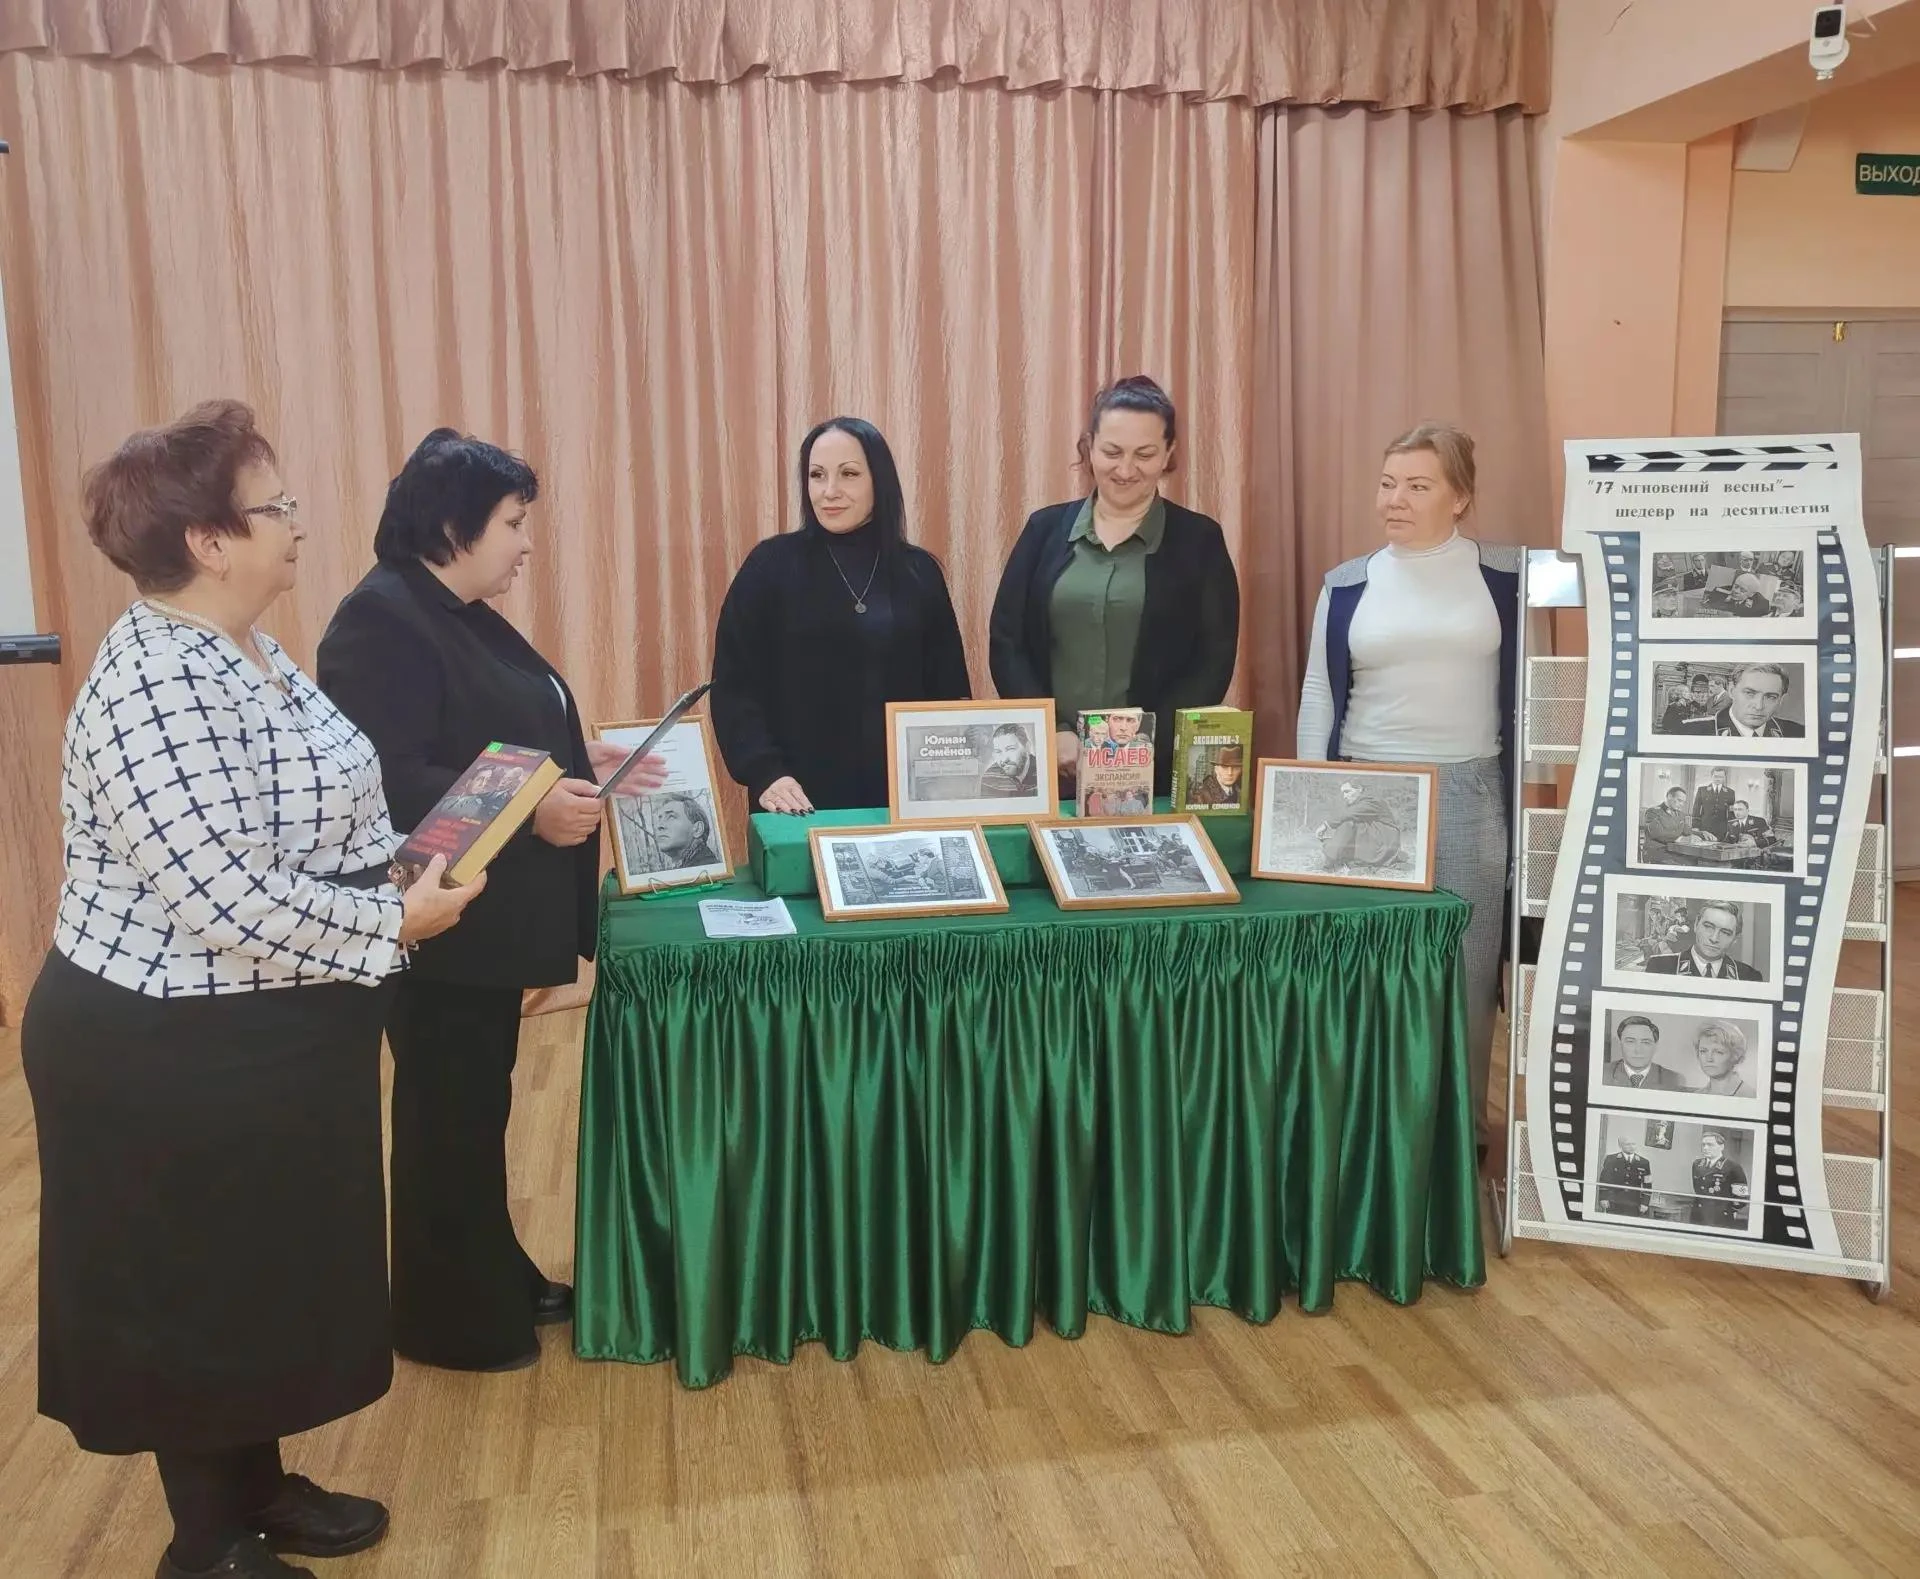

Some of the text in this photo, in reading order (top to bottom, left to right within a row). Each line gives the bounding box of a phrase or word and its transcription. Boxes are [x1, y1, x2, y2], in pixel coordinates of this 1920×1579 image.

[1620, 480, 1709, 495] мгновений
[1615, 503, 1830, 520] шедевр на десятилетия
[924, 735, 967, 745] Юлиан
[1087, 747, 1151, 768] ИСАЕВ
[1094, 772, 1141, 782] ЭКСПАНСИЯ
